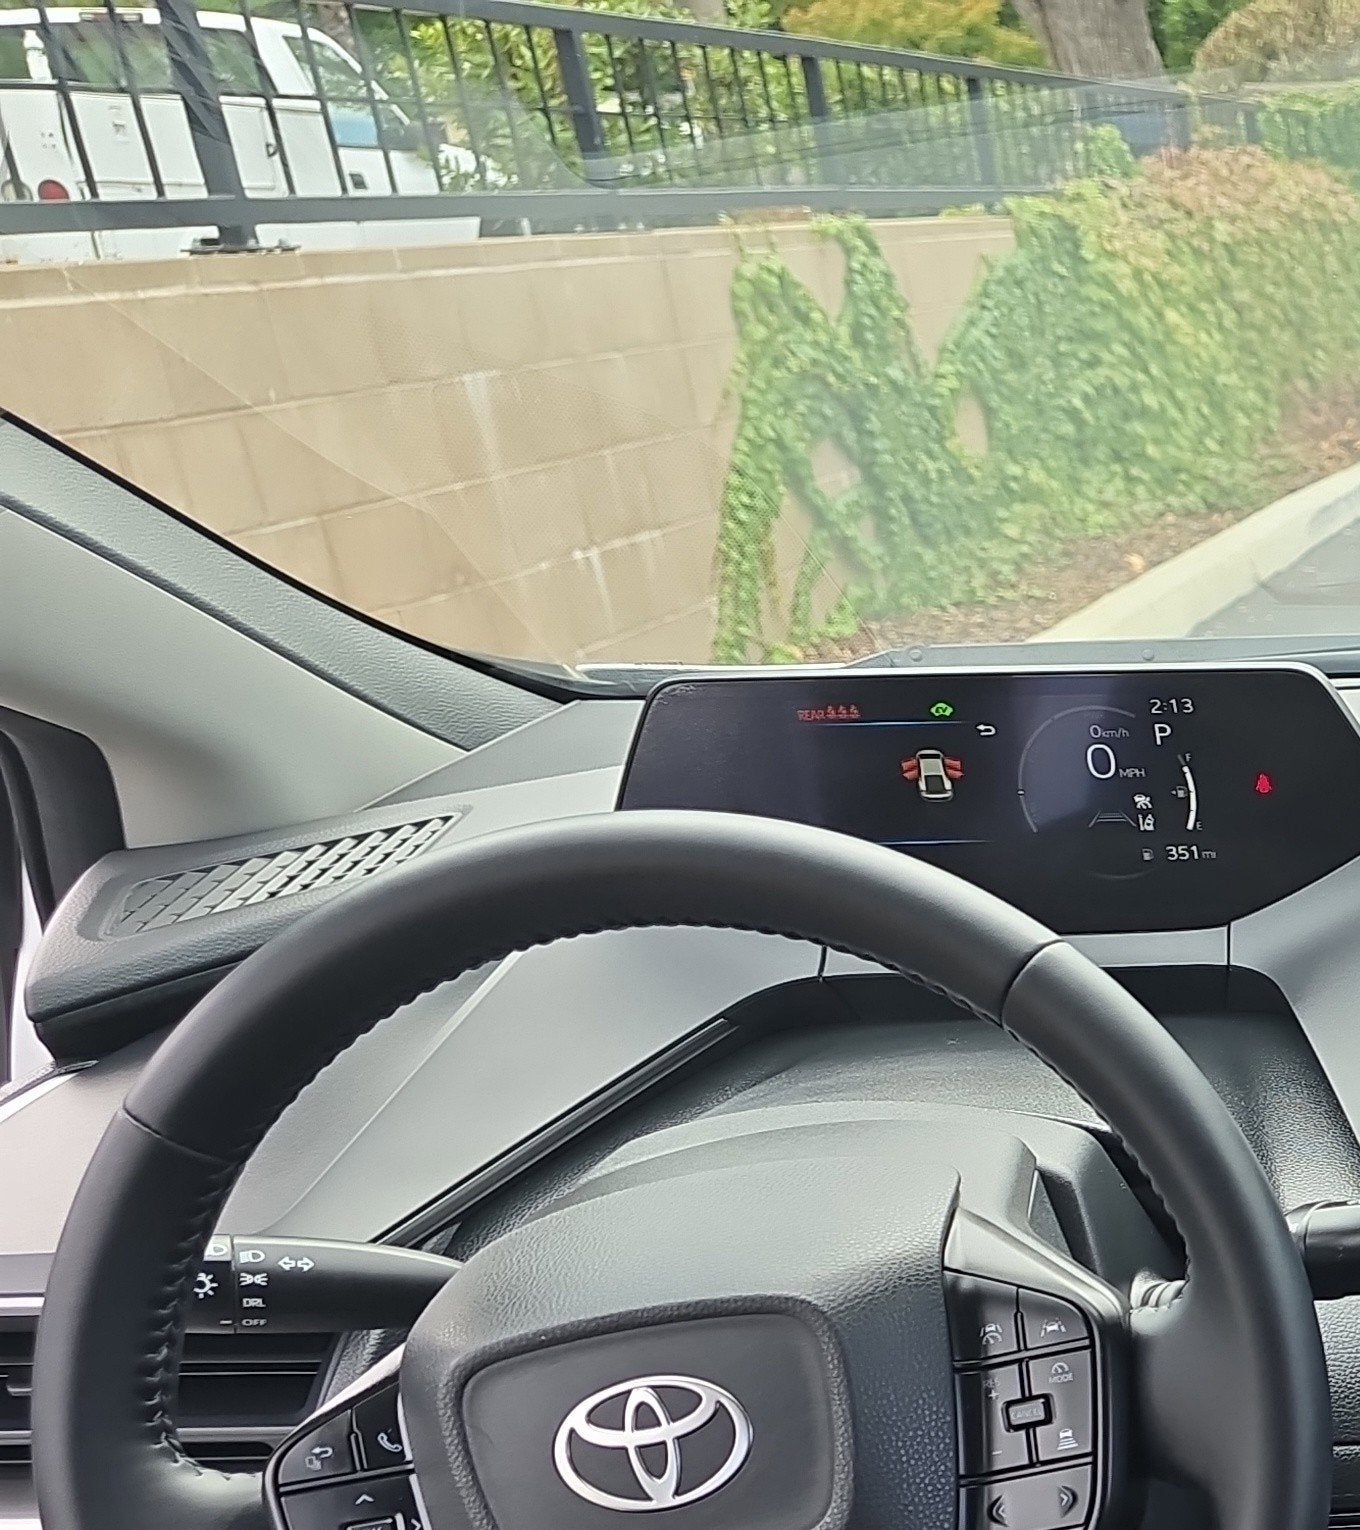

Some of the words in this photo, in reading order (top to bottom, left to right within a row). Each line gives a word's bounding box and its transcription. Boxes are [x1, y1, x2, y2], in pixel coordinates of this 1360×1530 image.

[1150, 698, 1194, 714] 2:13
[797, 709, 826, 721] REAR
[1154, 723, 1172, 745] P
[1086, 743, 1116, 779] 0
[1118, 768, 1146, 778] MPH
[1185, 753, 1192, 762] F
[1165, 845, 1200, 861] 351
[242, 1297, 266, 1308] DRL
[241, 1318, 267, 1327] OFF
